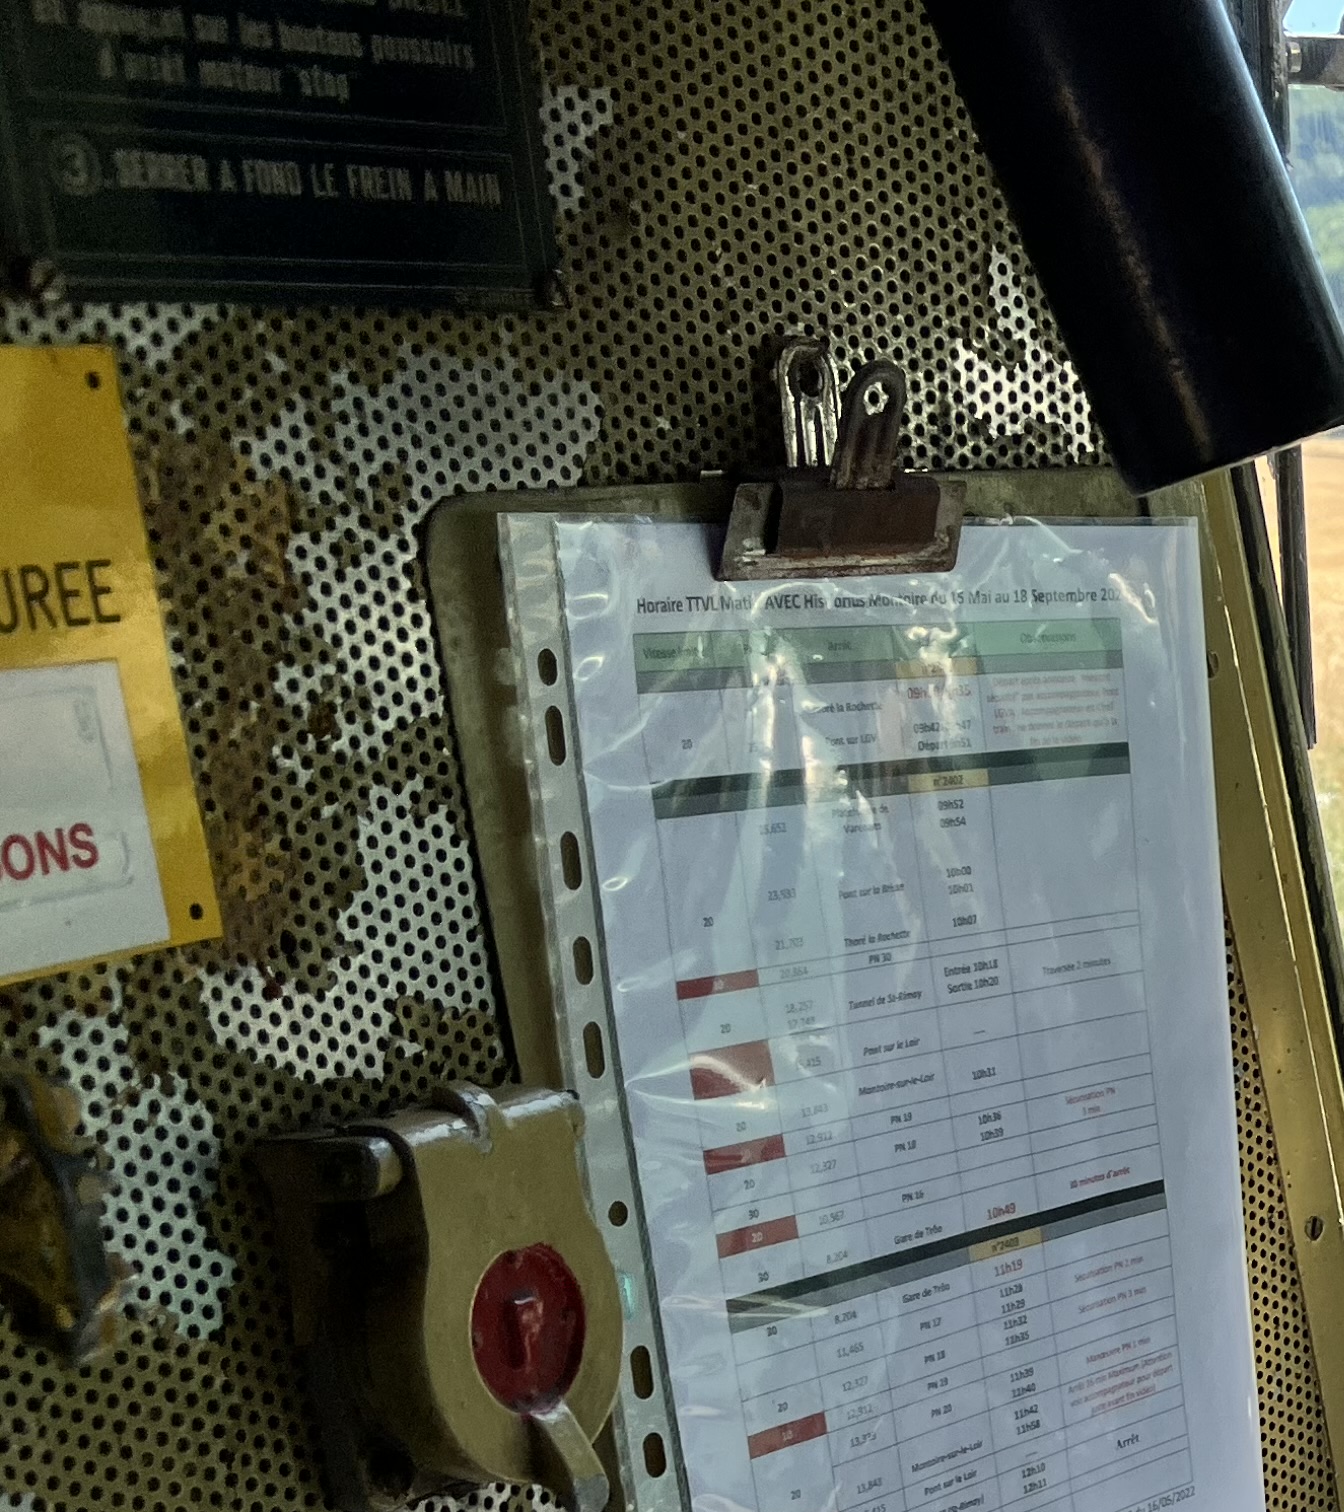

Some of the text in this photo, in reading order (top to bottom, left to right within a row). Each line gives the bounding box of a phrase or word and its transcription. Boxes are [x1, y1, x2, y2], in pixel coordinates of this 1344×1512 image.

[311, 164, 335, 197] LE
[348, 165, 412, 202] FREIN
[424, 170, 437, 202] A
[637, 598, 683, 613] Horaire
[686, 597, 717, 611] TTVL
[765, 594, 801, 609] AVEC
[969, 590, 992, 603] Mai
[996, 592, 1010, 602] au
[1014, 589, 1027, 602] 18
[1031, 588, 1097, 605] Septembre
[1101, 589, 1125, 601] 202
[994, 1259, 1023, 1277] 11h19
[1116, 1433, 1140, 1449] Arrêt
